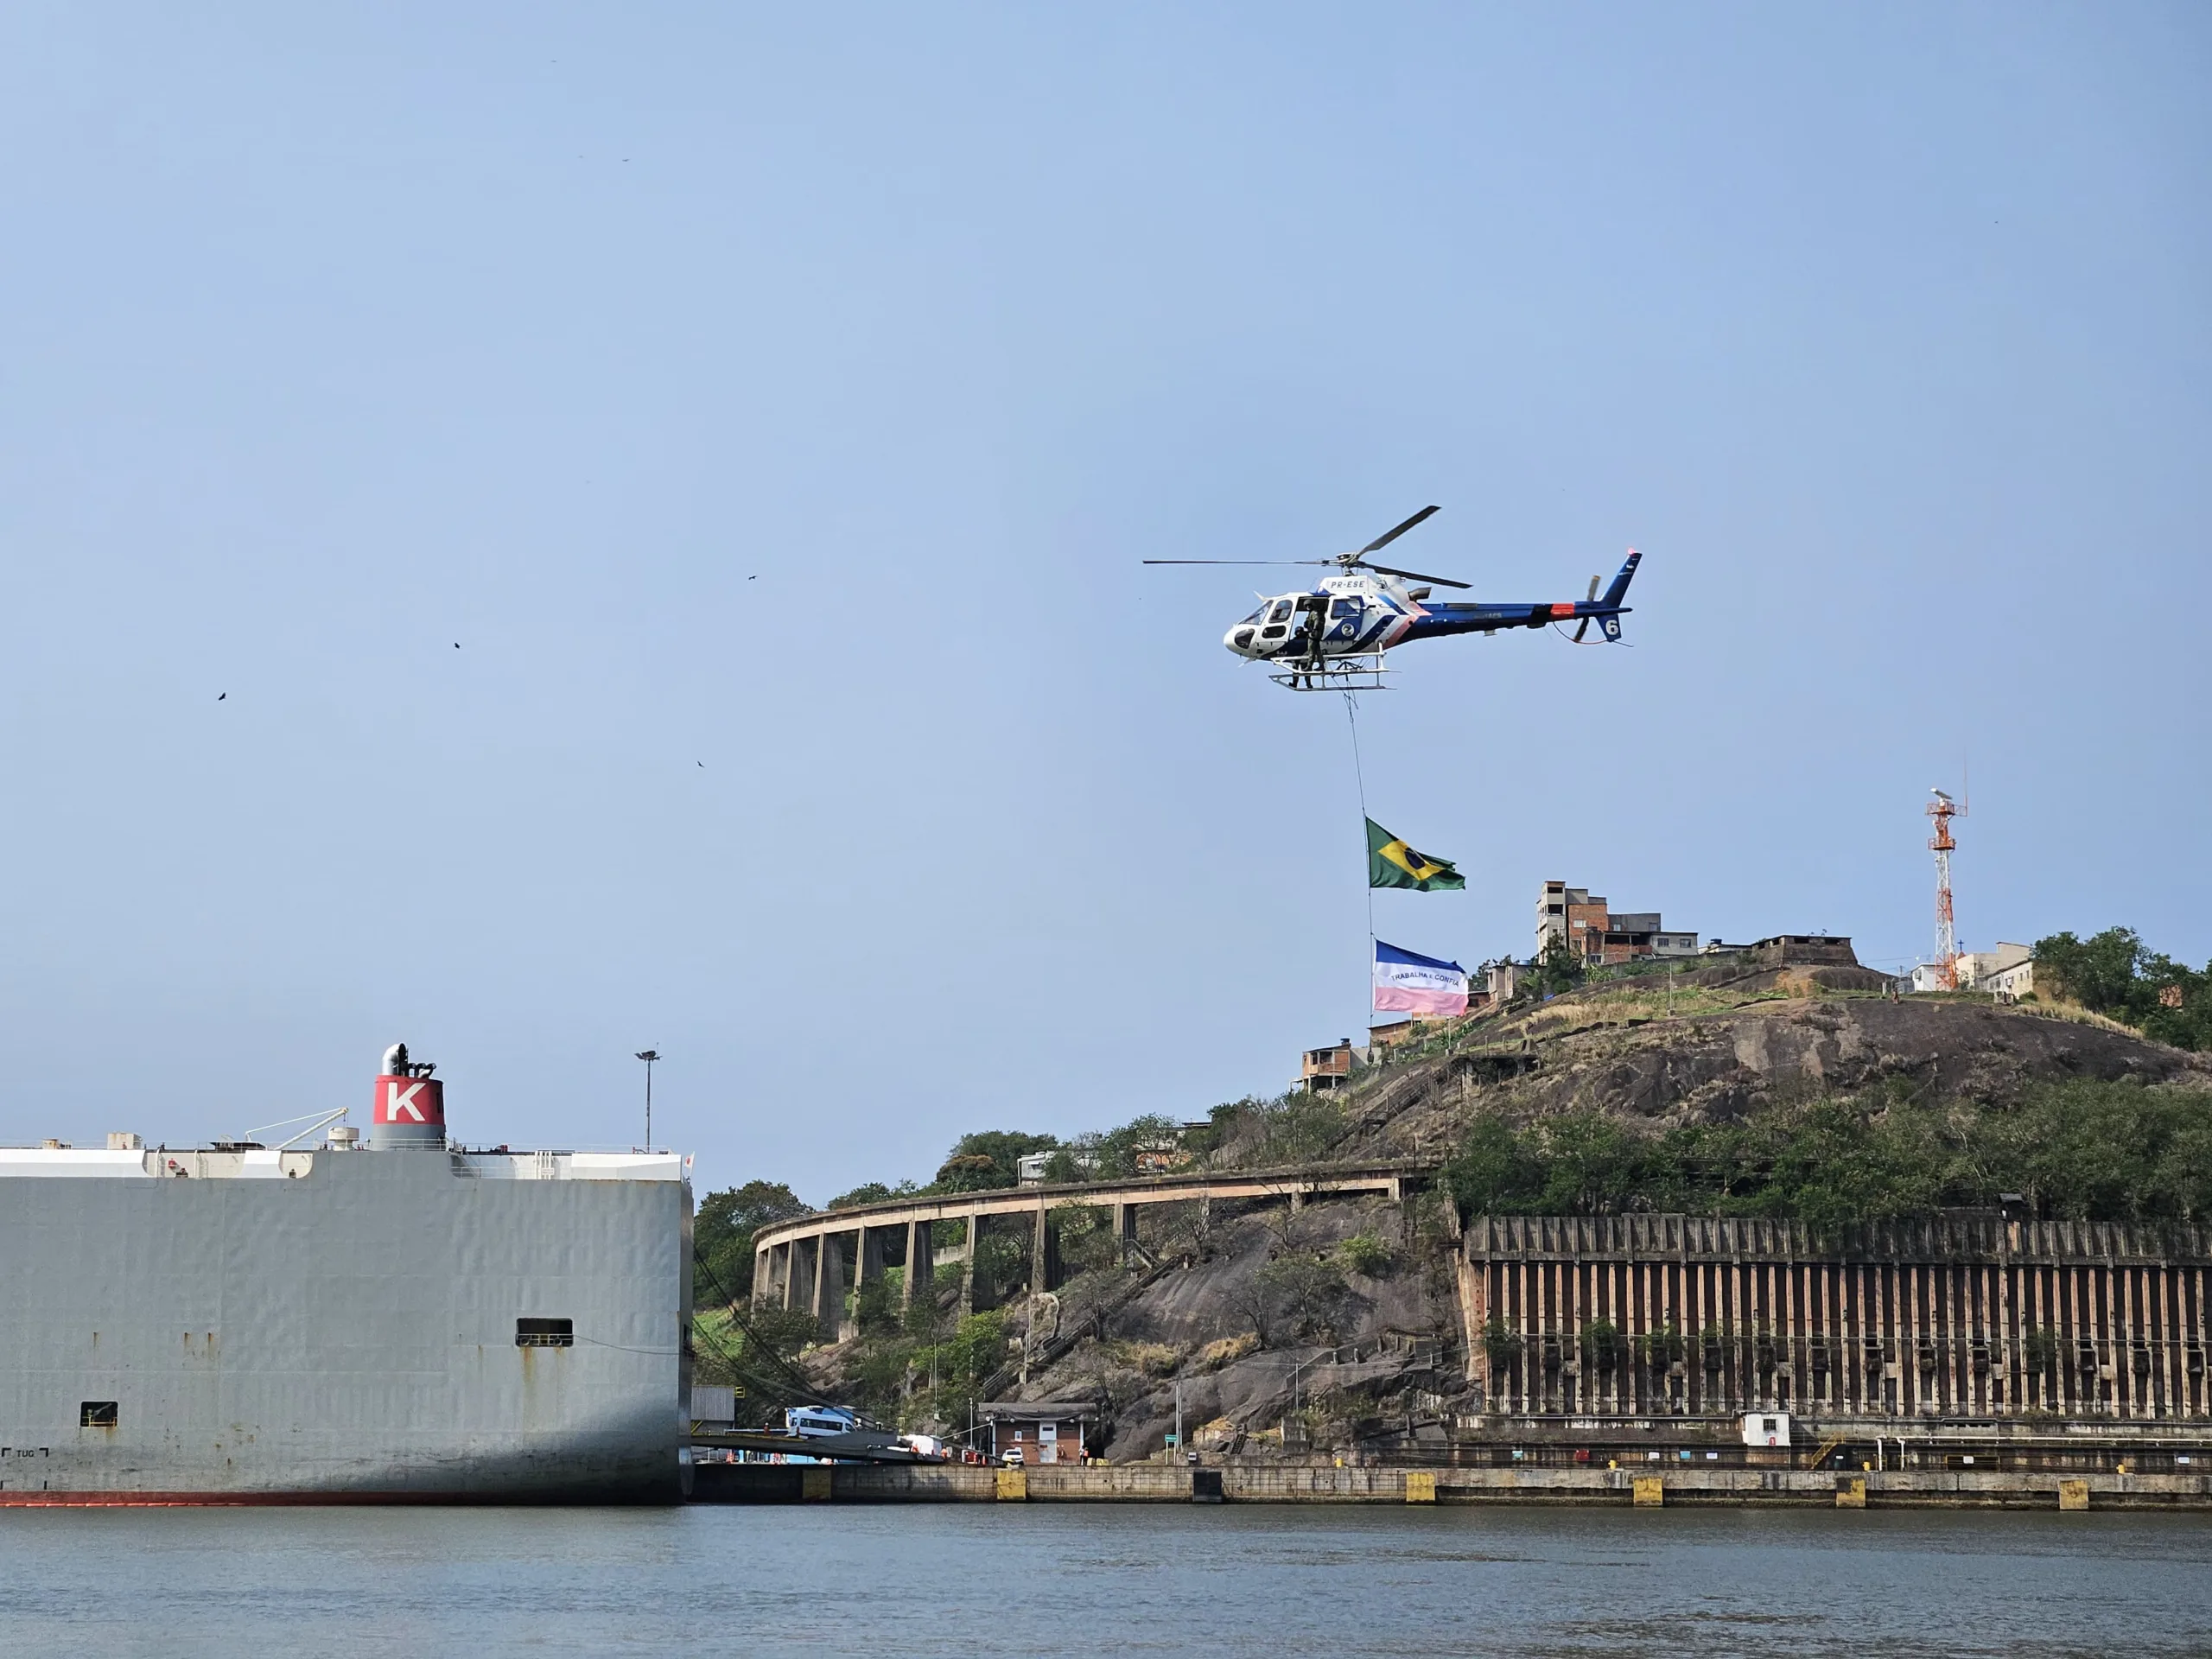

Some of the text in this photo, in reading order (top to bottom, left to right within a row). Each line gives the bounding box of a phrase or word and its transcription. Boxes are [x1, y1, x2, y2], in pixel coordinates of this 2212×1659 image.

[1605, 620, 1619, 636] 6
[1391, 971, 1427, 982] TRABALHA
[1434, 974, 1459, 987] CONFIA
[387, 1082, 427, 1122] K
